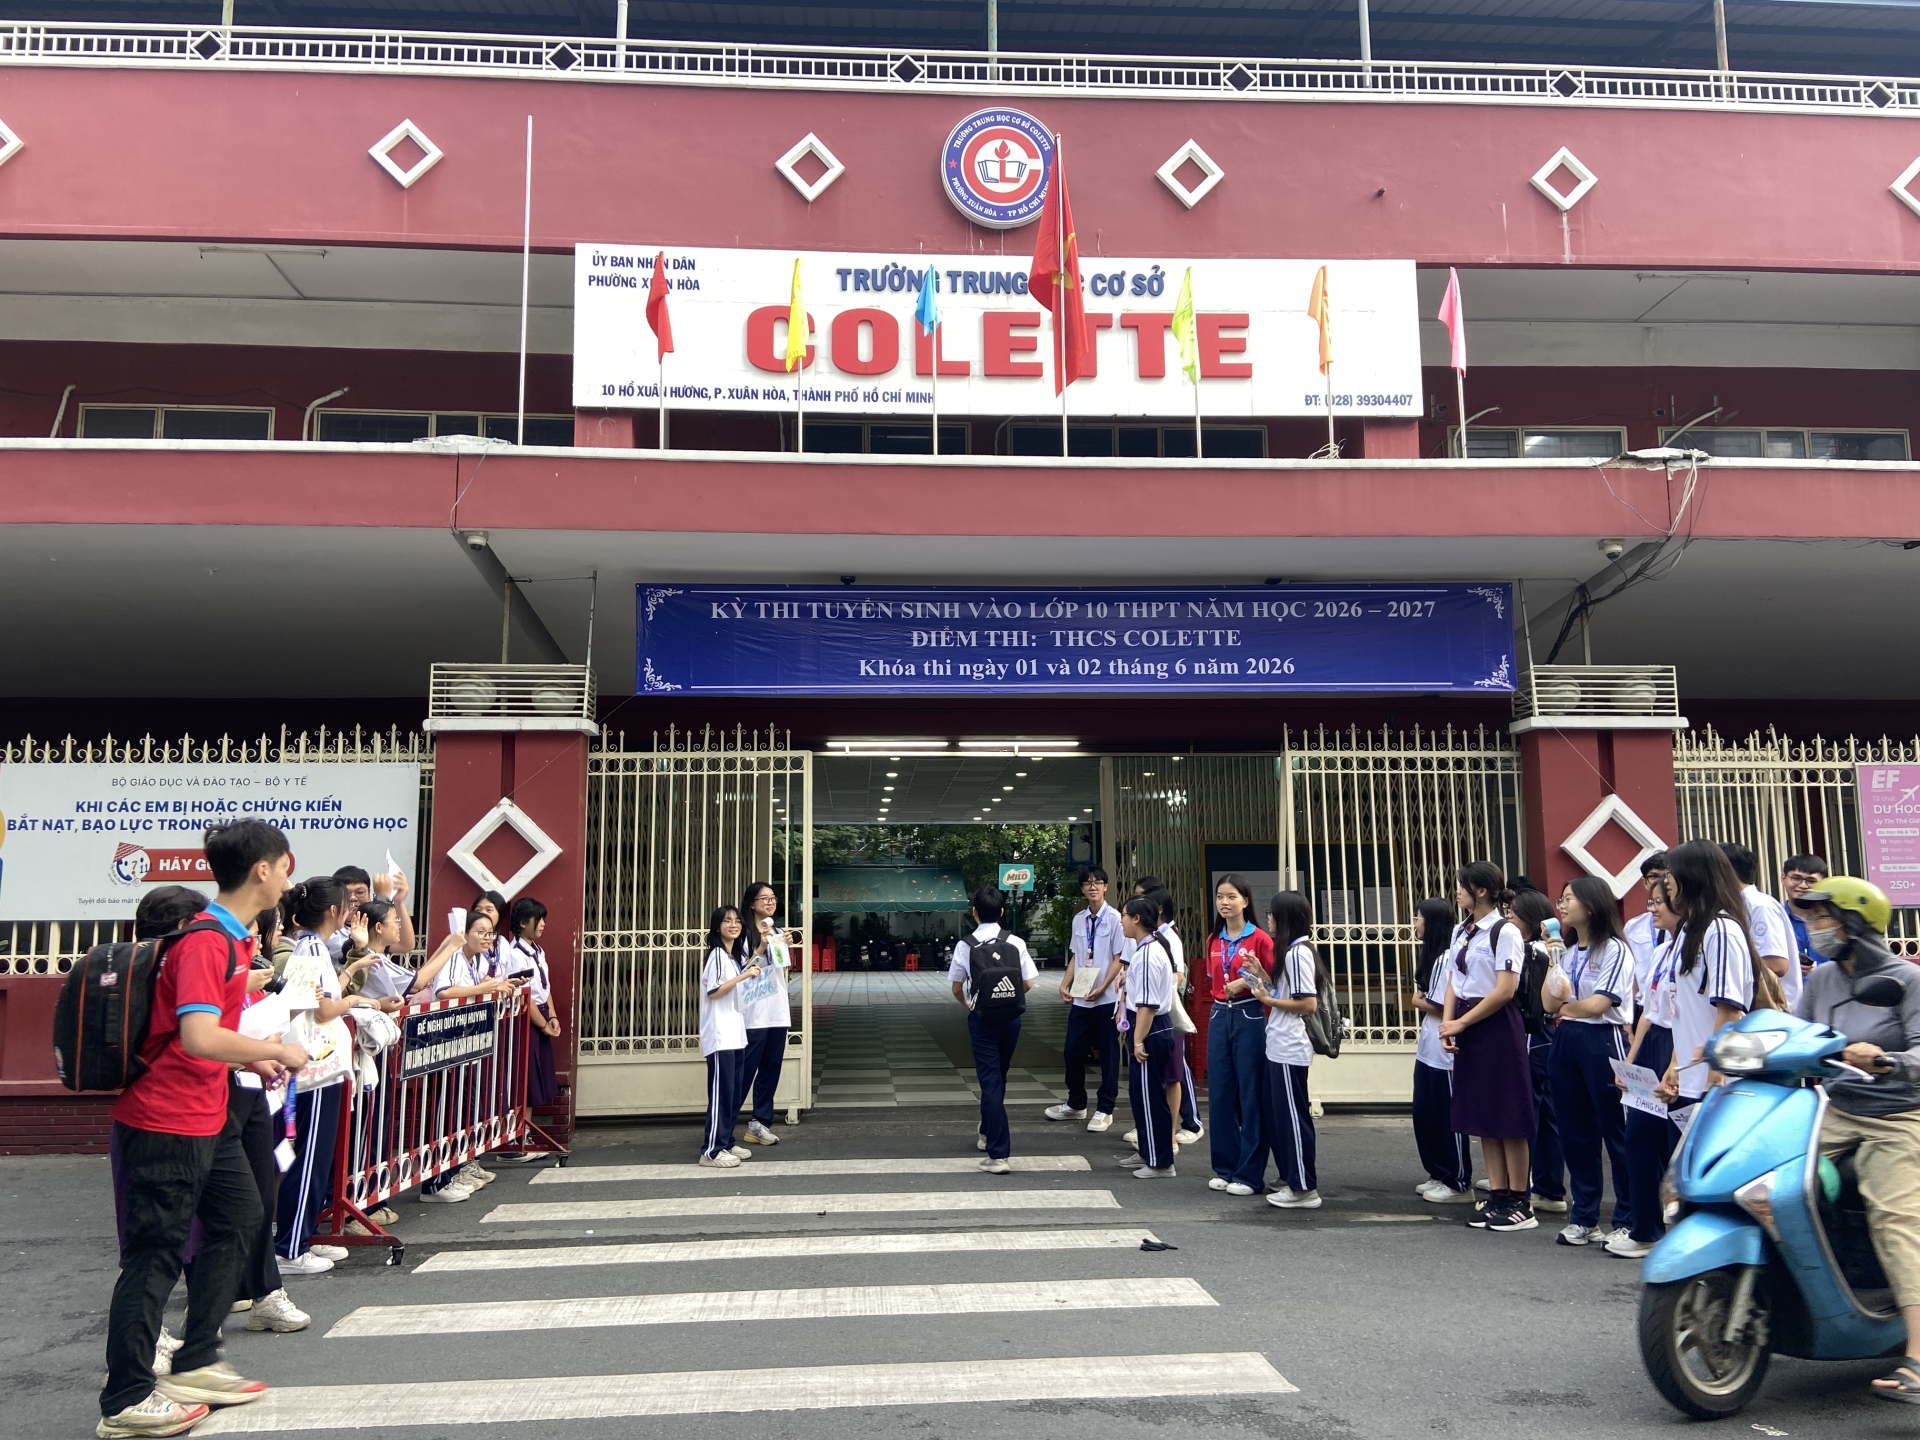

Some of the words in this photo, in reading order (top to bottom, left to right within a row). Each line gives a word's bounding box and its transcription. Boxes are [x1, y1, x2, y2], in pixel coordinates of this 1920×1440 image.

[954, 125, 973, 148] TRƯỜNG
[972, 116, 995, 128] TRUNG
[996, 115, 1010, 123] HỌC
[1012, 116, 1022, 124] CƠ
[1030, 126, 1050, 152] COLETTE
[952, 177, 968, 200] PHƯỜNG
[966, 197, 983, 213] XUÂN
[984, 207, 997, 217] HÒA
[592, 250, 608, 267] ỦY
[610, 255, 634, 268] BAN
[672, 256, 696, 270] DÂN
[588, 272, 637, 289] PHƯỜNG
[642, 278, 673, 290] XN
[677, 276, 700, 290] HÒA
[946, 270, 1028, 294] TRUNG
[1090, 270, 1126, 296] CƠ
[1131, 265, 1165, 296] SỞ
[602, 384, 615, 396] 10
[619, 380, 634, 397] HỒ
[670, 385, 711, 401] HƯƠNG,
[728, 386, 758, 400] XUÂN
[762, 386, 790, 402] HÒA,
[793, 387, 831, 401] THÀNH
[835, 387, 859, 402] PHỐ
[863, 386, 879, 402] HỒ
[882, 388, 902, 403] CHÍ
[1304, 394, 1321, 406] ĐT:
[1356, 394, 1413, 406] 39304407
[710, 597, 748, 618] KỲ
[754, 602, 800, 618] THI
[806, 598, 894, 618] TUYỂN
[902, 602, 961, 618] SINH
[968, 598, 1022, 619] VÀO
[1029, 598, 1078, 619] LỚP
[1086, 602, 1108, 618] 10
[1115, 602, 1180, 618] THPT
[1188, 597, 1245, 618] NĂM
[1252, 601, 1307, 622] HỌC
[1314, 601, 1363, 618] 2026
[1387, 601, 1436, 618] 2027
[910, 626, 978, 646] ĐIỂM
[984, 630, 1037, 647] THI:
[1050, 630, 1116, 647] THCS
[1124, 630, 1242, 646] COLETTE
[858, 658, 916, 676] Khóa
[923, 659, 952, 676] thi
[958, 659, 1009, 680] ngày
[1016, 659, 1038, 676] 01
[1046, 659, 1070, 676] và
[1078, 658, 1102, 675] 02
[1108, 658, 1168, 680] tháng
[1174, 658, 1187, 675] 6
[1194, 658, 1240, 675] năm
[1246, 658, 1295, 675] 2026
[112, 776, 127, 787] BỘ
[130, 776, 156, 787] GIÁO
[160, 778, 182, 788] DỤC
[186, 776, 200, 787] VÀ
[203, 776, 226, 786] ĐÀO
[230, 778, 251, 788] TẠO
[266, 776, 280, 787] BỘ
[284, 777, 291, 786] Y
[295, 775, 308, 786] TẾ
[1872, 770, 1900, 788] EF
[76, 801, 103, 813] KHI
[107, 798, 141, 813] CÁC
[146, 801, 169, 812] EM
[172, 801, 187, 815] BỊ
[192, 798, 238, 816] HOẶC
[242, 797, 302, 812] CHỨNG
[306, 795, 342, 812] KIẾN
[1874, 805, 1891, 814] DU
[7, 814, 38, 831] BẮT
[42, 819, 78, 834] NẠT,
[82, 819, 116, 834] BẠO
[120, 819, 154, 834] LỰC
[158, 818, 214, 830] TRONG
[300, 815, 369, 830] TRƯỜNG
[373, 818, 408, 832] HỌC
[160, 857, 192, 871] HÃY
[1890, 881, 1916, 890] 250+
